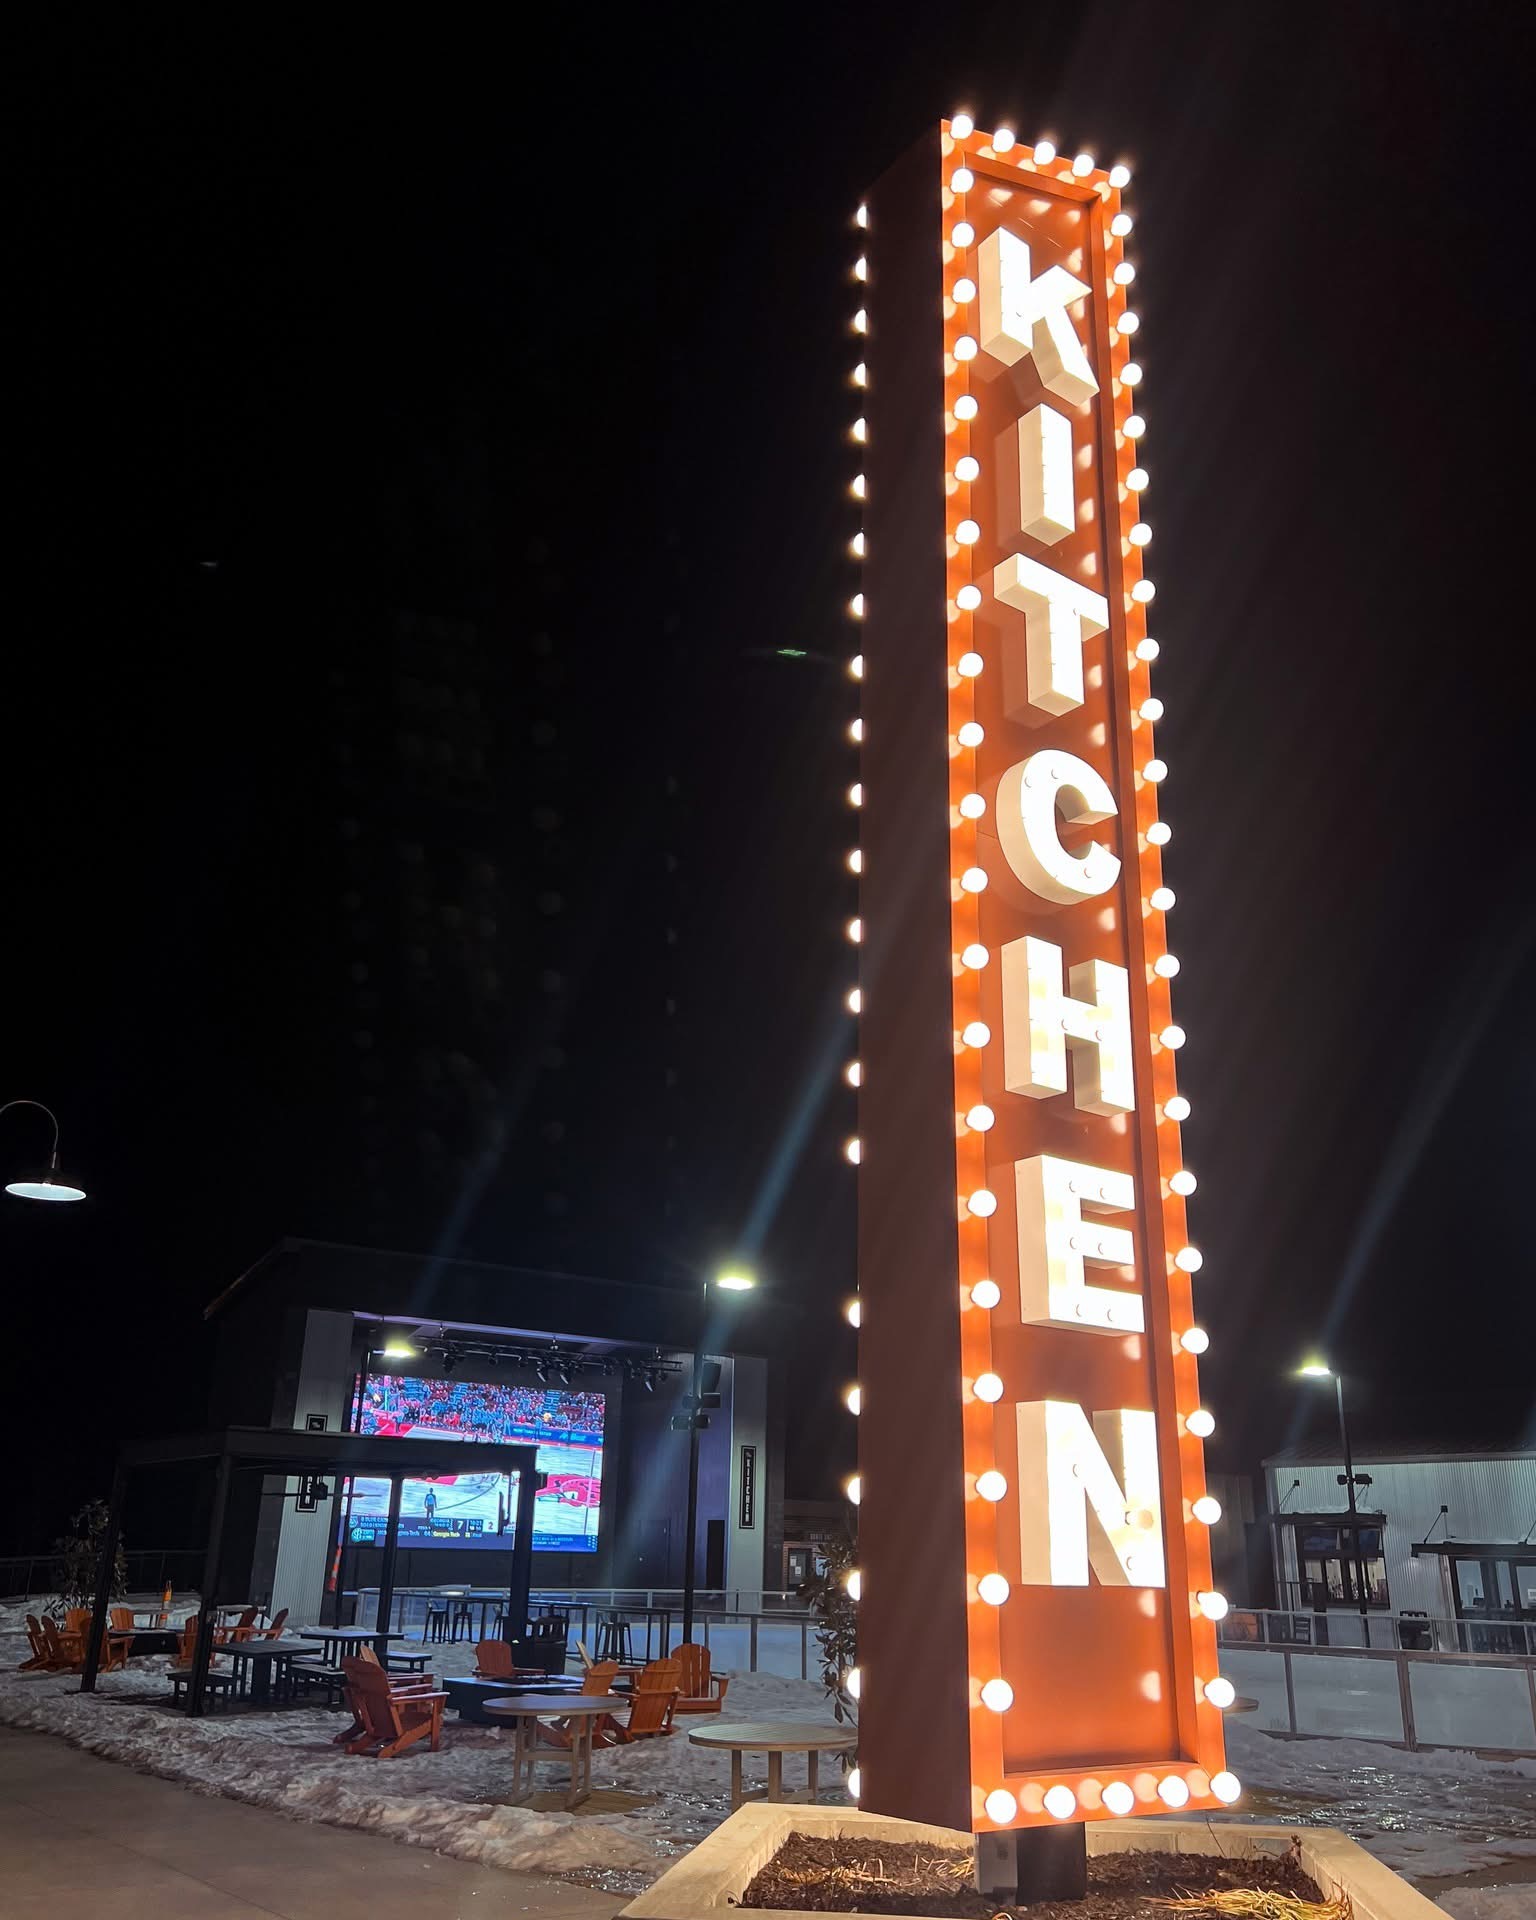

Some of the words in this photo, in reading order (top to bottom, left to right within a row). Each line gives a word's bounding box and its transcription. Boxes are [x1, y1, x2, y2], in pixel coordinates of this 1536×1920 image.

[978, 226, 1167, 1588] KITCHEN
[457, 1520, 464, 1530] 7
[487, 1521, 494, 1530] 2
